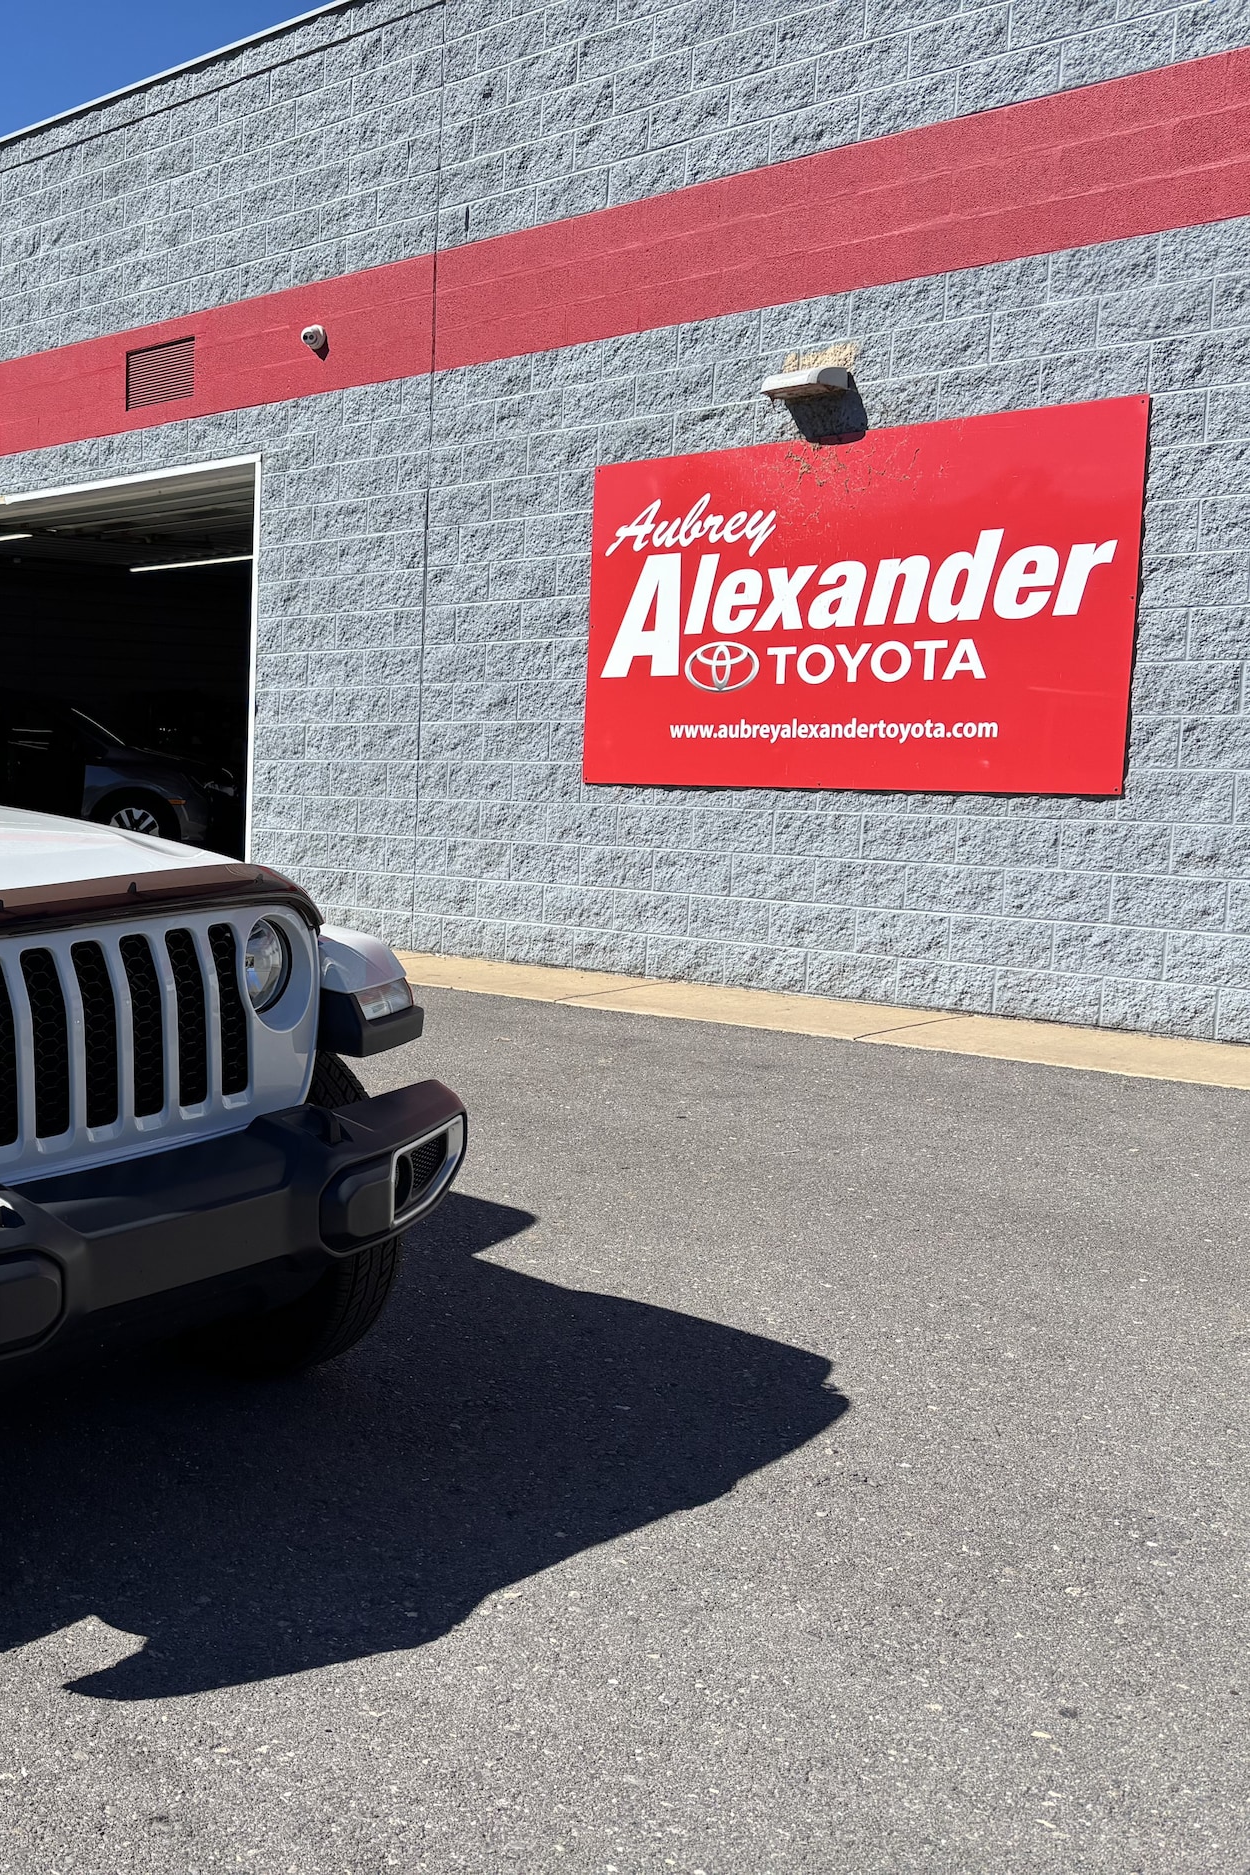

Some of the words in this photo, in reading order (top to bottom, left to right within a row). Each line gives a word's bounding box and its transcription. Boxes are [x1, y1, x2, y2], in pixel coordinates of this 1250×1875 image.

[604, 493, 777, 557] Aubrey
[601, 528, 1118, 679] Alexander
[766, 638, 987, 685] TOYOTA
[669, 718, 999, 744] www.aubreyalexandertoyota.com
